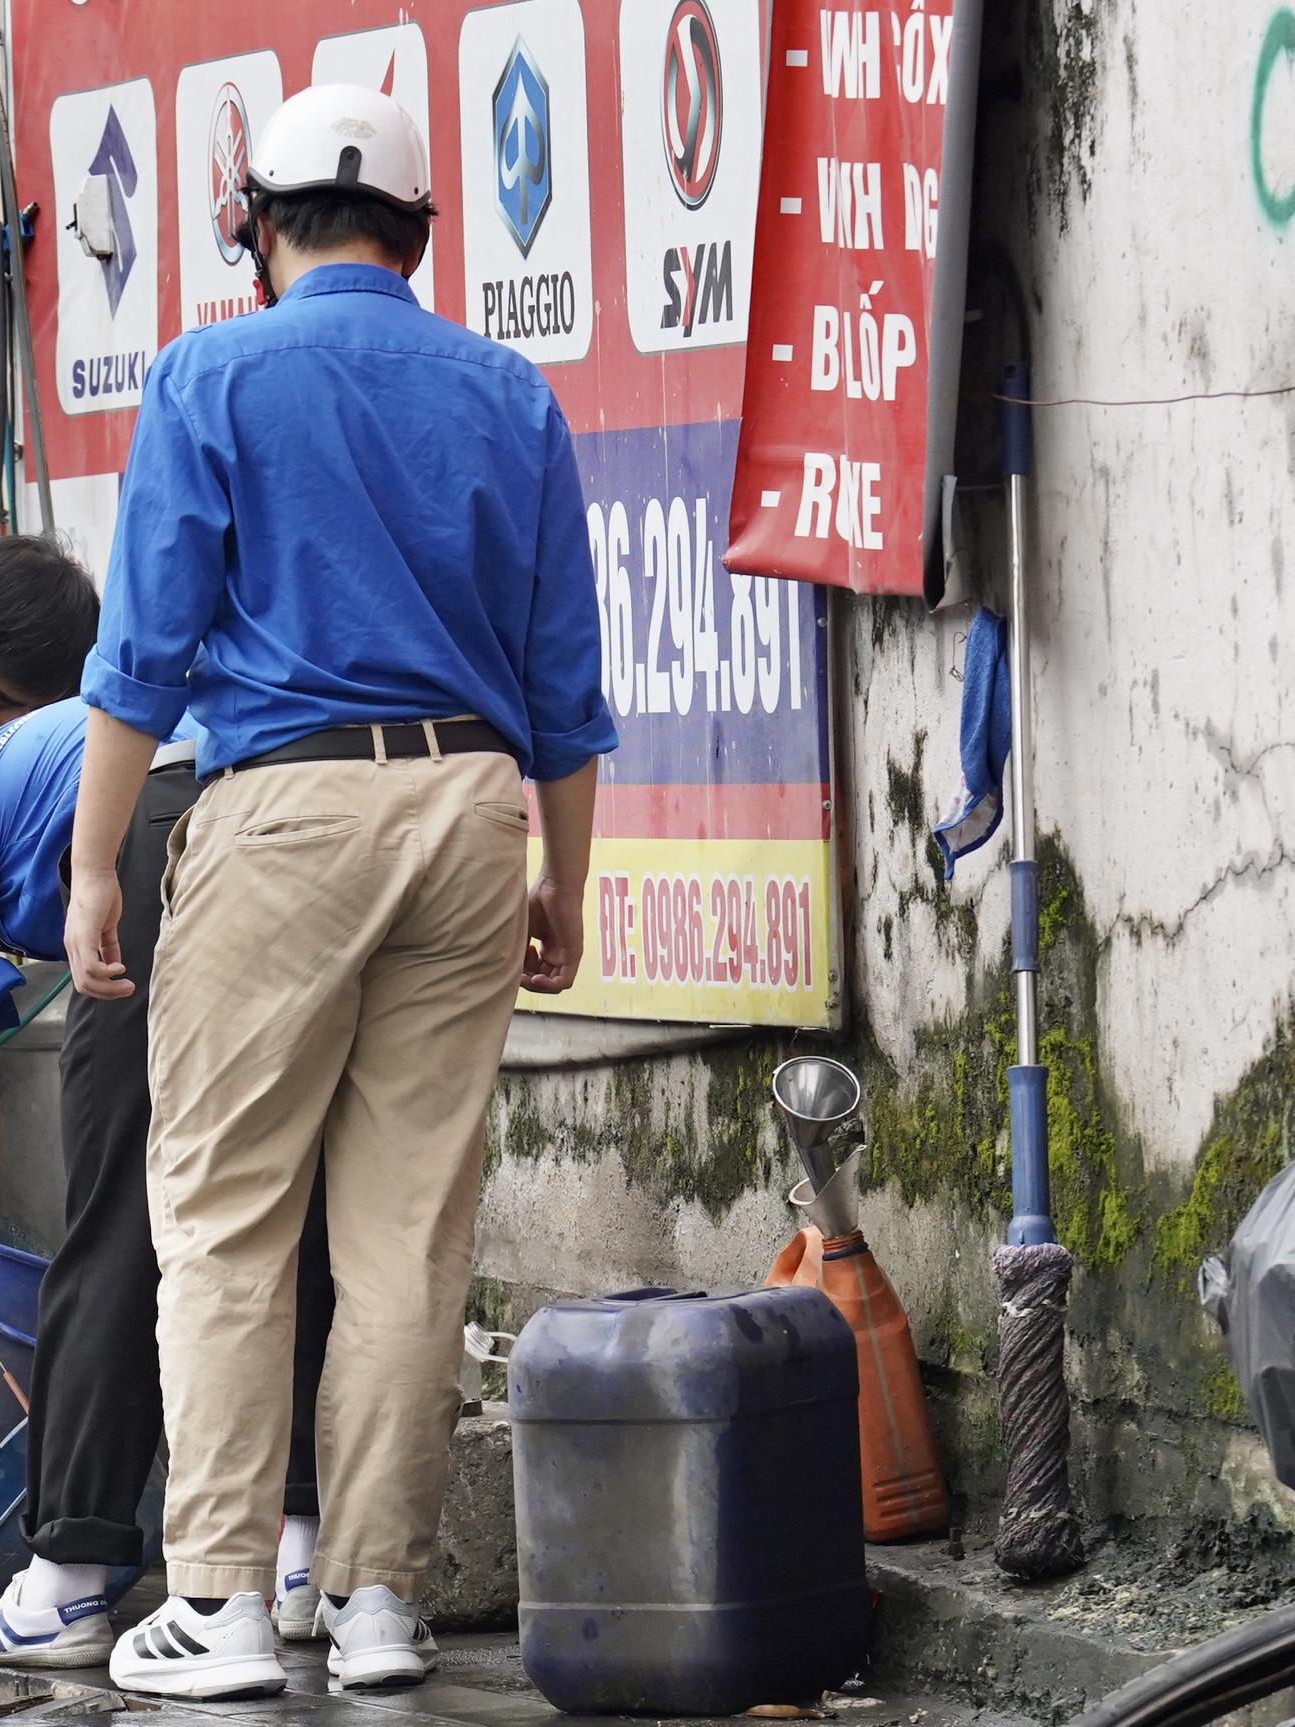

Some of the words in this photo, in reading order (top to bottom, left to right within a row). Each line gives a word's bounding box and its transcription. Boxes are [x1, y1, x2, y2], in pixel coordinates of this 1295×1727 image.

[482, 271, 575, 340] PIAGGIO
[660, 240, 733, 338] SYM
[72, 351, 146, 399] SUZUKI
[641, 877, 812, 987] 0986.294.891
[63, 1600, 99, 1614] THUONG
